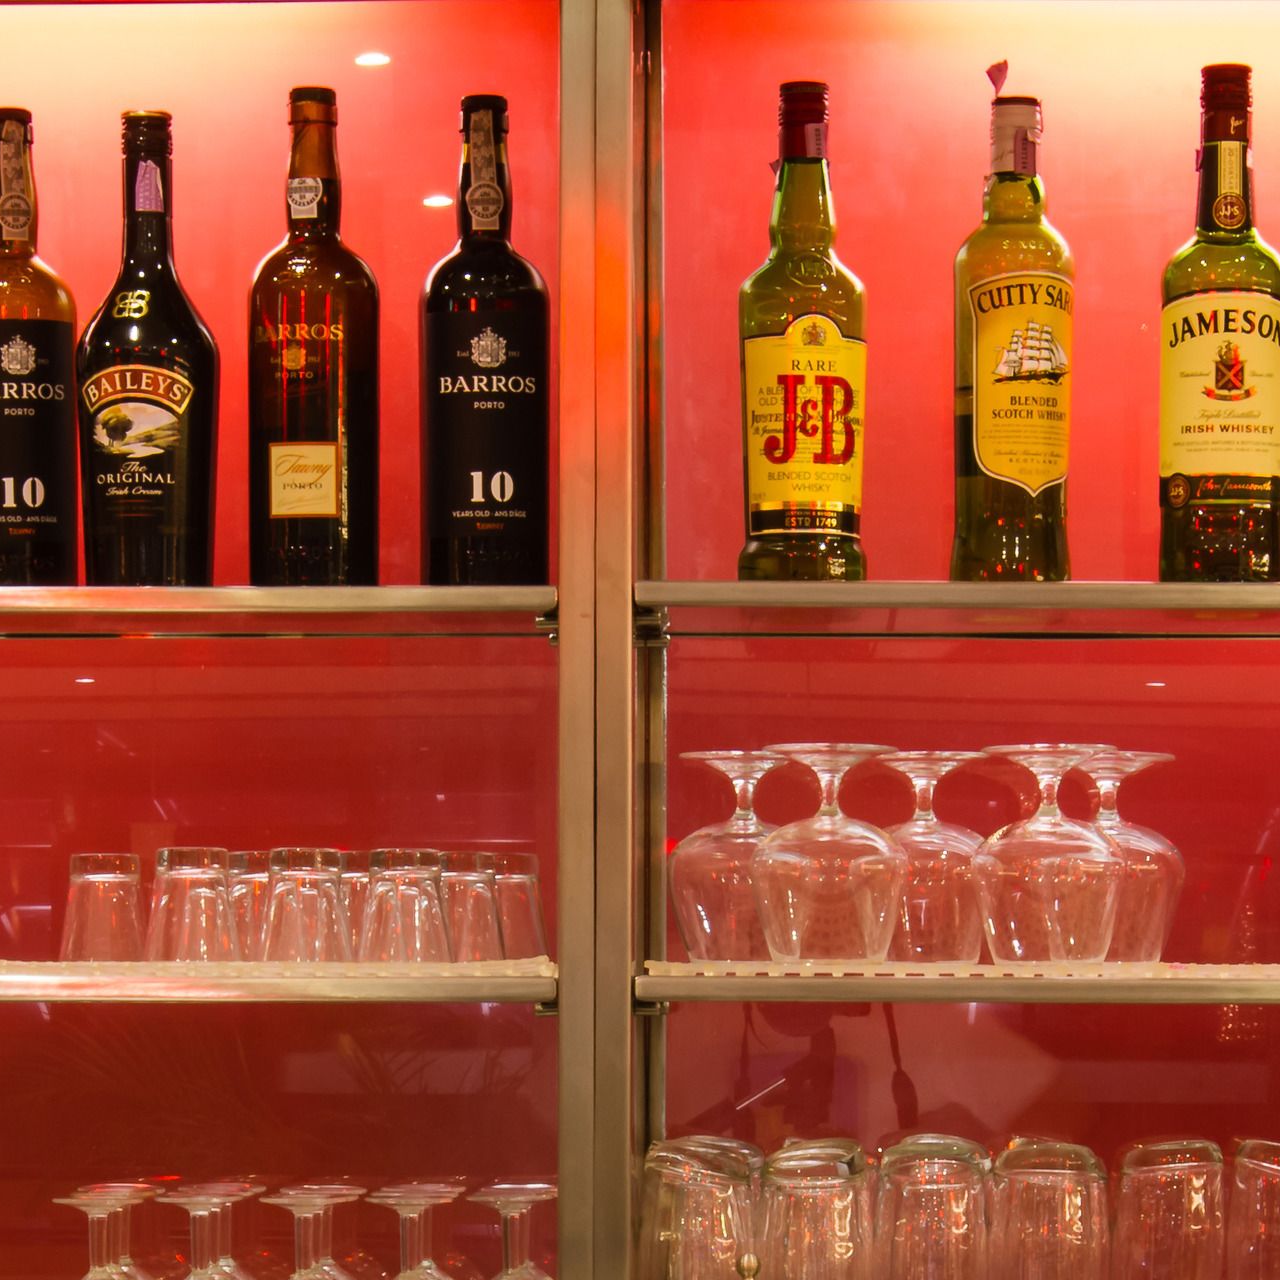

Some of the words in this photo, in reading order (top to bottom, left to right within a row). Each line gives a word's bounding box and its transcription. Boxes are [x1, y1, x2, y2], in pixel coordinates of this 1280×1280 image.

[976, 284, 1043, 314] CUTTY
[791, 359, 837, 372] RARE
[275, 371, 314, 379] PORTO
[87, 371, 187, 403] BAILEYS
[440, 375, 536, 394] BARROS
[758, 397, 778, 406] OLD
[1010, 396, 1058, 408] BLENDED
[4, 408, 35, 416] PORTO
[991, 409, 1033, 420] SCOTCH
[1180, 424, 1215, 435] IRISH
[1219, 424, 1274, 435] WHISKEY
[120, 461, 148, 473] The
[97, 472, 175, 485] ORIGINAL
[767, 472, 811, 481] BLENDED
[814, 472, 851, 482] SCOTCH
[1, 476, 45, 508] 10
[105, 486, 129, 496] Irish
[470, 471, 514, 503] 10
[792, 483, 831, 493] WHISKY
[452, 510, 474, 518] YEARS
[474, 510, 490, 518] OLD
[816, 517, 837, 528] 1749
